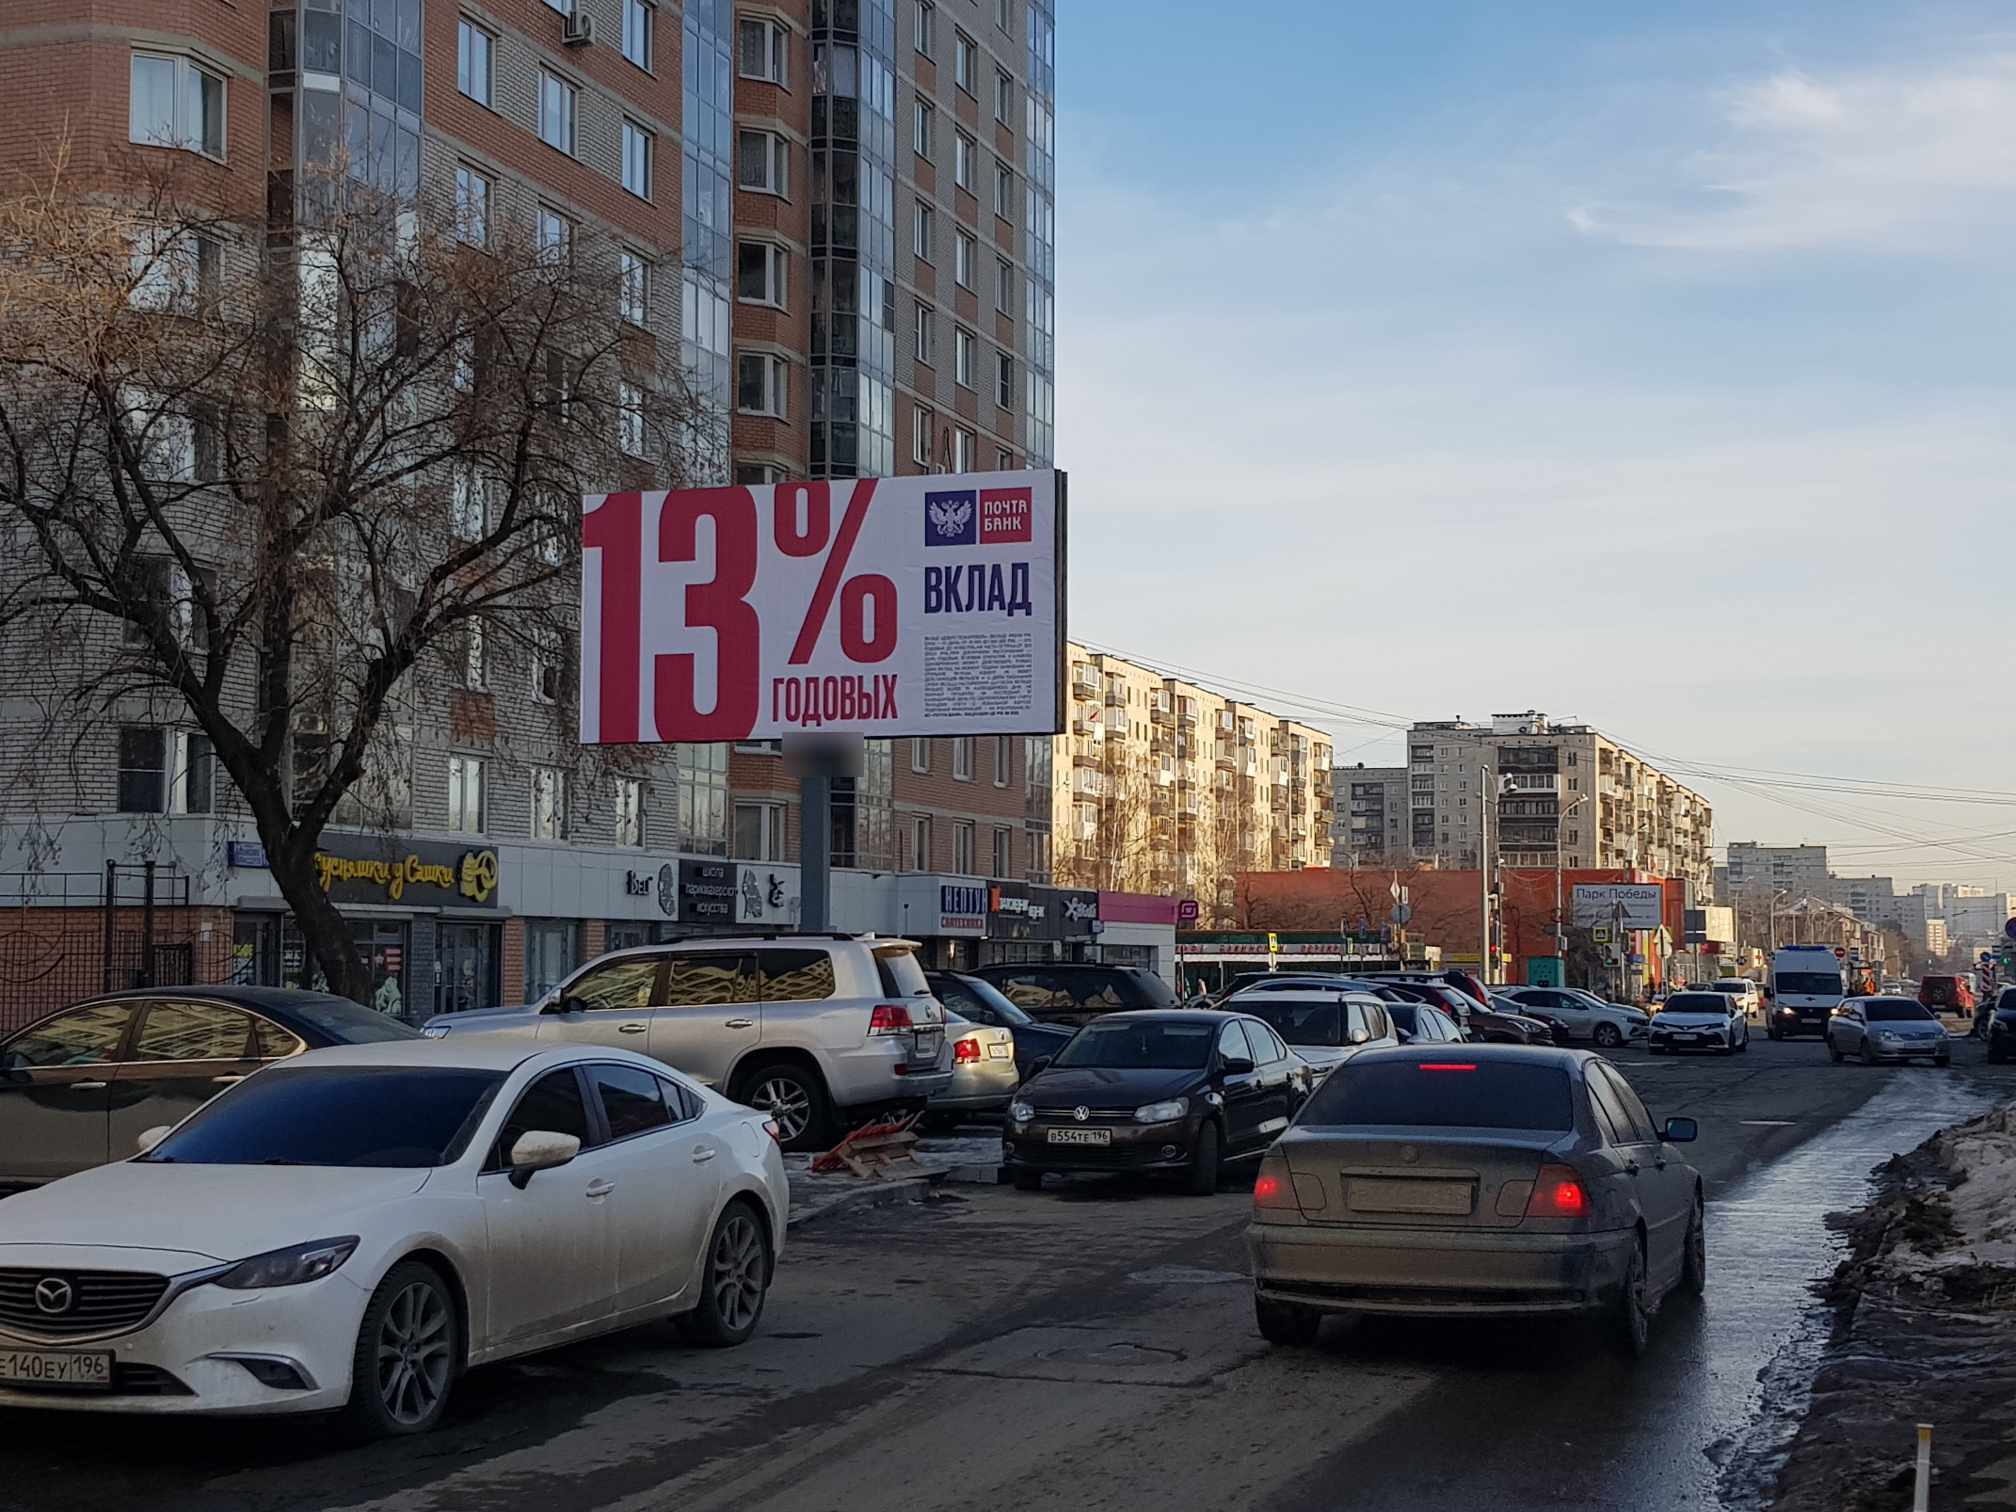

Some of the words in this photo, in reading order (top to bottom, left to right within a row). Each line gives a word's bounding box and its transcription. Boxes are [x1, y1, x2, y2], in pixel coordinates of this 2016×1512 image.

[984, 499, 1028, 515] ПОЧТА
[984, 516, 1022, 532] БАНК
[924, 562, 1032, 617] ВКЛАД
[583, 477, 898, 742] 13%
[772, 674, 898, 727] ГОДОВЫХ
[404, 854, 455, 888] Сашки
[945, 884, 988, 913] НЕПТУН
[1576, 887, 1605, 900] Парк
[1609, 887, 1657, 900] Победы
[73, 1356, 104, 1375] 196
